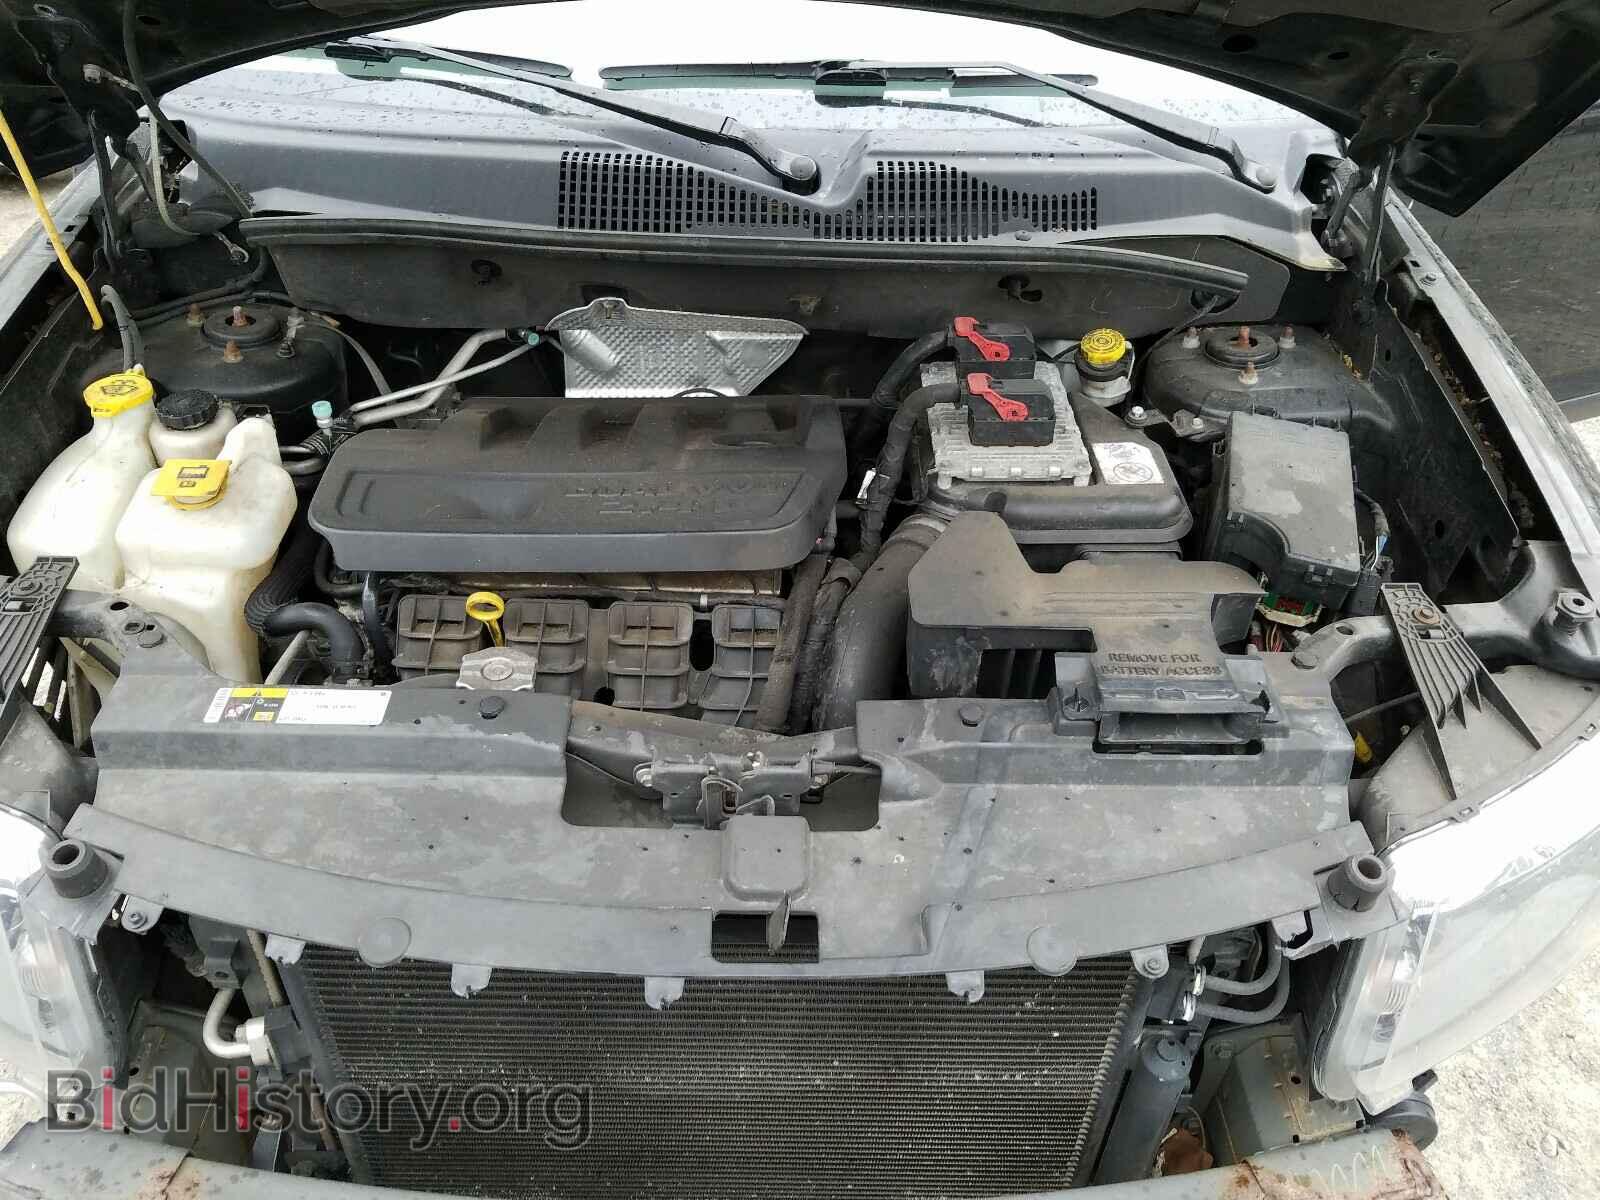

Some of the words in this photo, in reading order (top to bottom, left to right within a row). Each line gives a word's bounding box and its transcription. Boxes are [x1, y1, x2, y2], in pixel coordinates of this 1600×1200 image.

[1107, 652, 1169, 664] REMOVE
[1170, 652, 1203, 664] FOR
[1100, 664, 1161, 677] BATTERY
[1165, 664, 1223, 677] ACCESS
